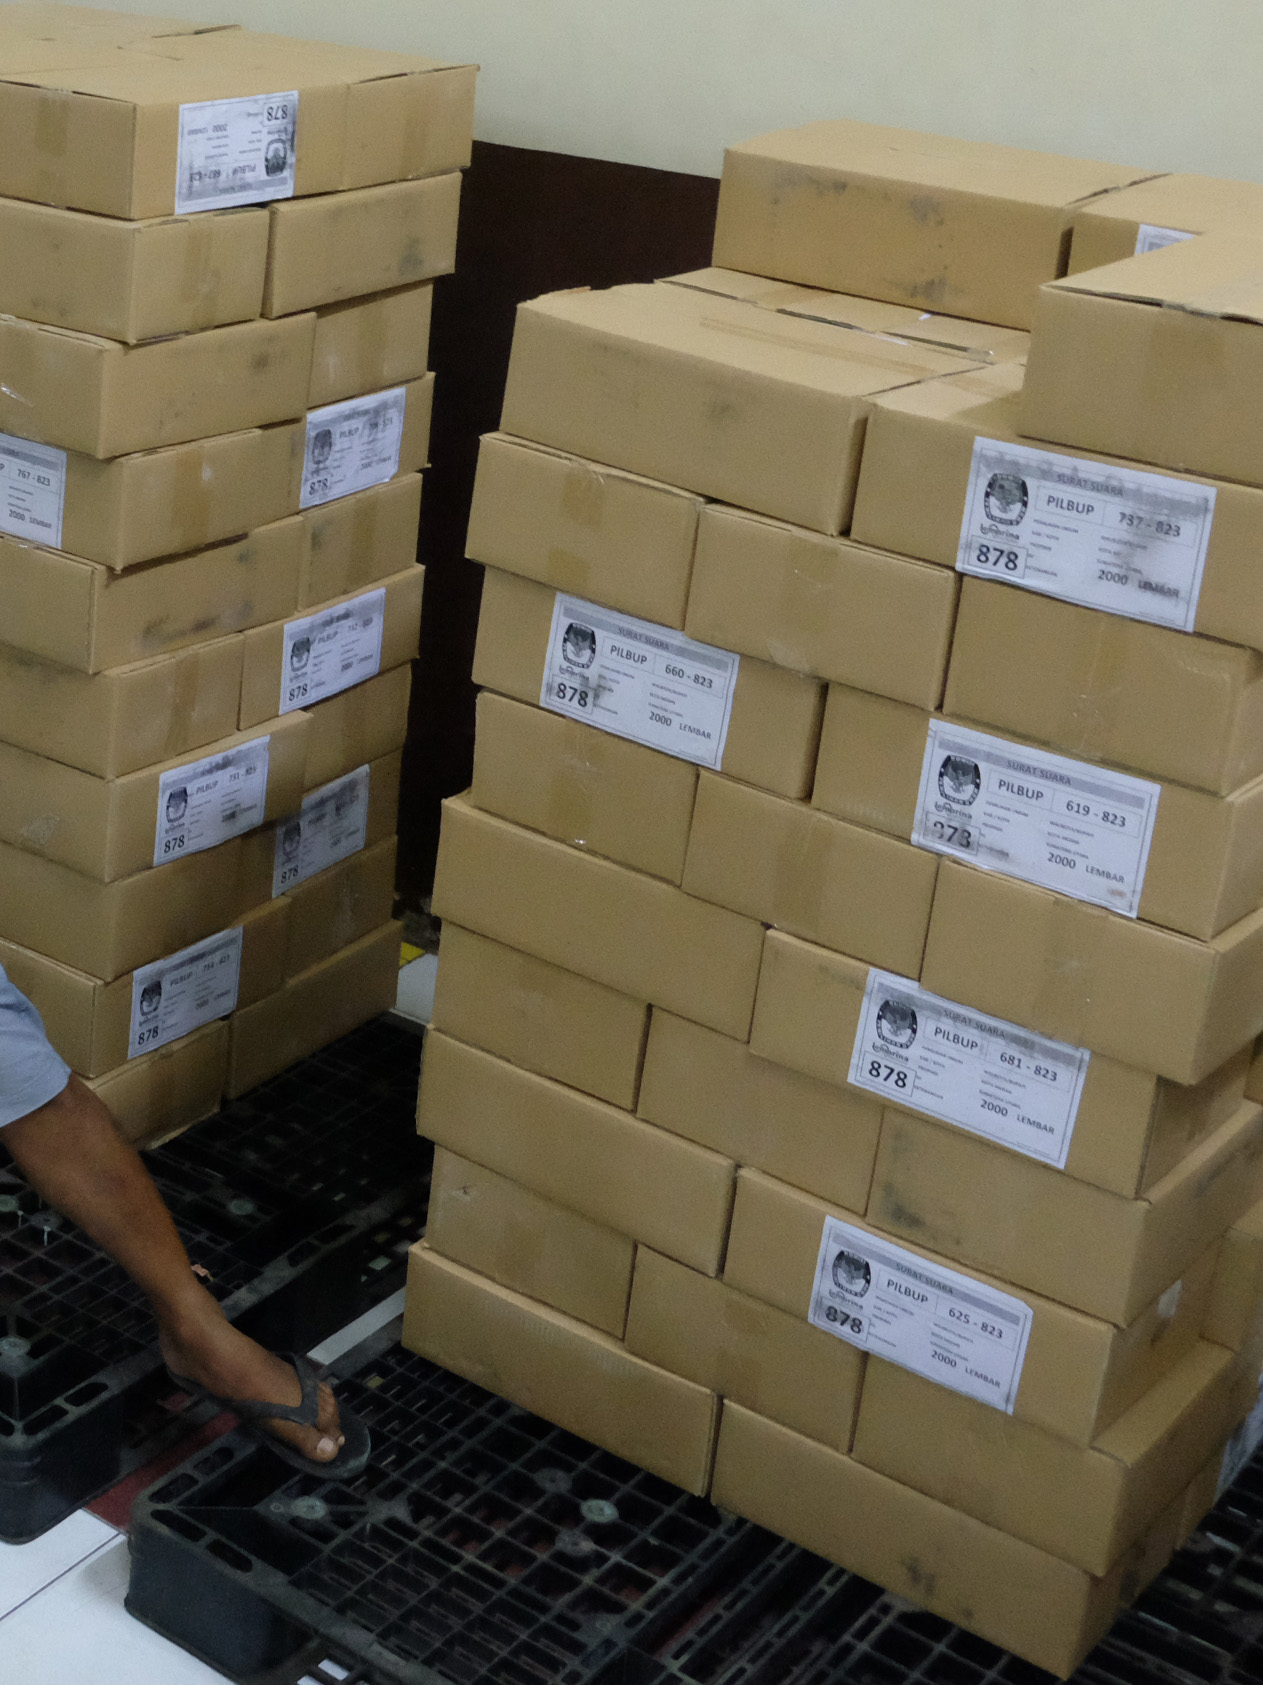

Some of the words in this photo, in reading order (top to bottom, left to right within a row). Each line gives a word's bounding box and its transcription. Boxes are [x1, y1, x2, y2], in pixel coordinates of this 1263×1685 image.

[266, 104, 288, 122] 878
[1047, 495, 1095, 516] PILBUP
[1156, 520, 1181, 537] 823
[976, 544, 1019, 571] 878
[1098, 569, 1129, 586] 2000
[610, 645, 648, 665] PILBUP
[665, 664, 685, 679] 660
[693, 674, 713, 689] 823
[288, 683, 308, 702] 878
[557, 682, 589, 708] 878
[649, 711, 672, 727] 2000
[679, 723, 712, 739] LEMBAR
[1007, 760, 1037, 775] SURAT
[1039, 769, 1072, 786] SUARA
[998, 779, 1044, 802] PILBUP
[1066, 800, 1090, 816] 619
[1101, 811, 1126, 827] 823
[164, 834, 185, 854] 878
[1047, 852, 1076, 869] 2000
[1085, 864, 1125, 884] LEMBAR
[138, 1025, 159, 1045] 878
[944, 1009, 972, 1029] SURAT
[975, 1020, 1006, 1038] SUARA
[934, 1027, 979, 1050] PILBUP
[868, 1060, 908, 1089] 878
[1000, 1052, 1022, 1069] 681
[1033, 1065, 1058, 1082] 823
[980, 1099, 1008, 1116] 2000
[1016, 1114, 1055, 1135] LEMBAR
[887, 1279, 929, 1304] PILBUP
[825, 1306, 863, 1334] 878
[949, 1307, 970, 1324] 625
[981, 1322, 1003, 1339] 823
[931, 1349, 957, 1368] 2000
[965, 1366, 1001, 1389] LEMBAR
